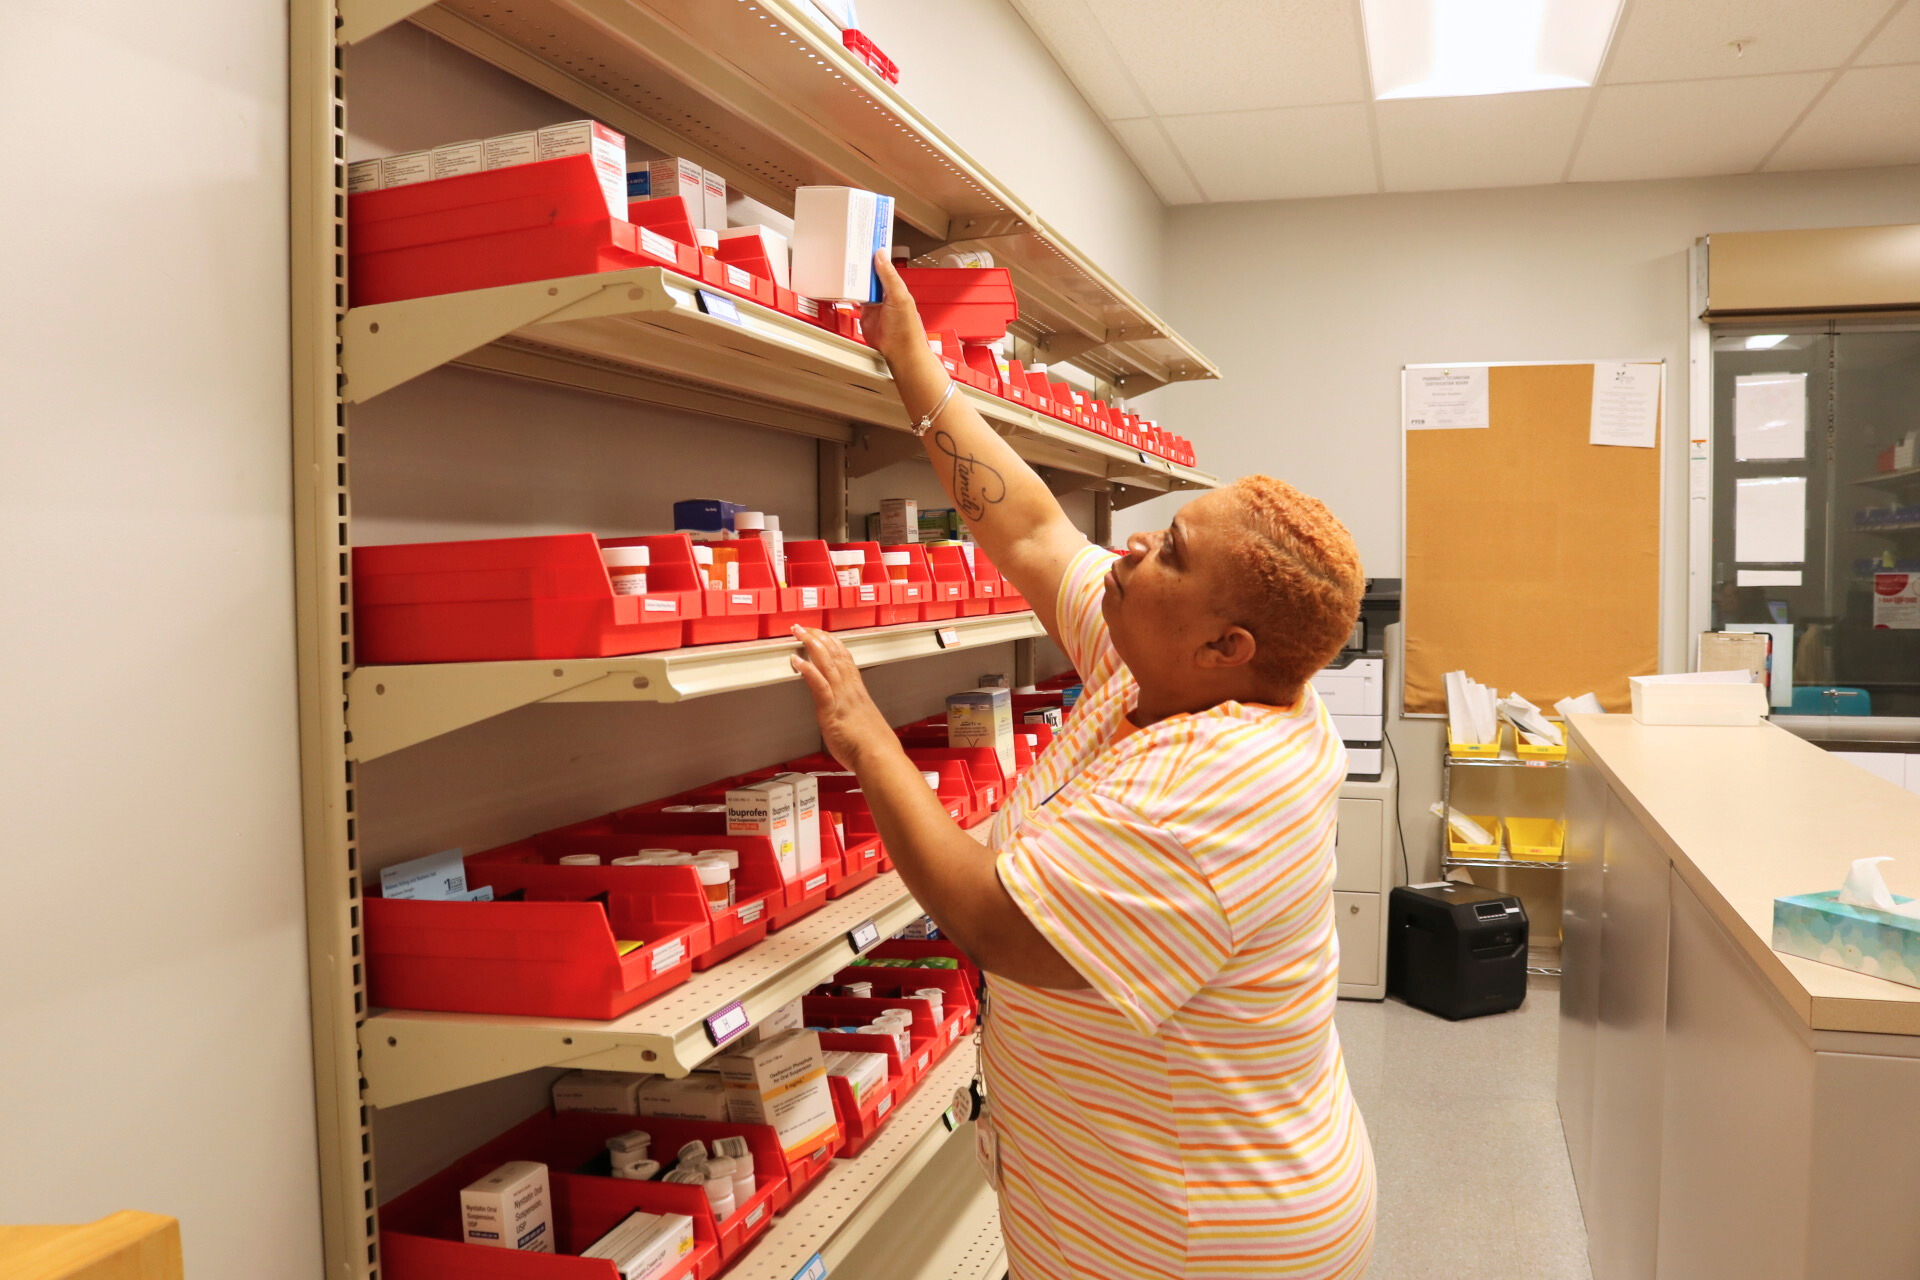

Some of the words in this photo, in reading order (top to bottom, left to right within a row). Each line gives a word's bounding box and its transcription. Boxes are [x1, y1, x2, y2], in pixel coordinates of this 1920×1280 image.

[1046, 713, 1058, 727] Nix
[728, 808, 768, 818] Ibuprofen
[772, 804, 790, 816] Ibuprofen
[722, 1017, 731, 1031] H
[792, 1056, 813, 1069] Phosphate
[780, 1073, 789, 1081] Oral
[790, 1064, 812, 1077] Suspension
[514, 1192, 534, 1209] Nystatin
[533, 1184, 543, 1197] Oral
[466, 1204, 486, 1212] Nystatin
[516, 1221, 526, 1234] USP
